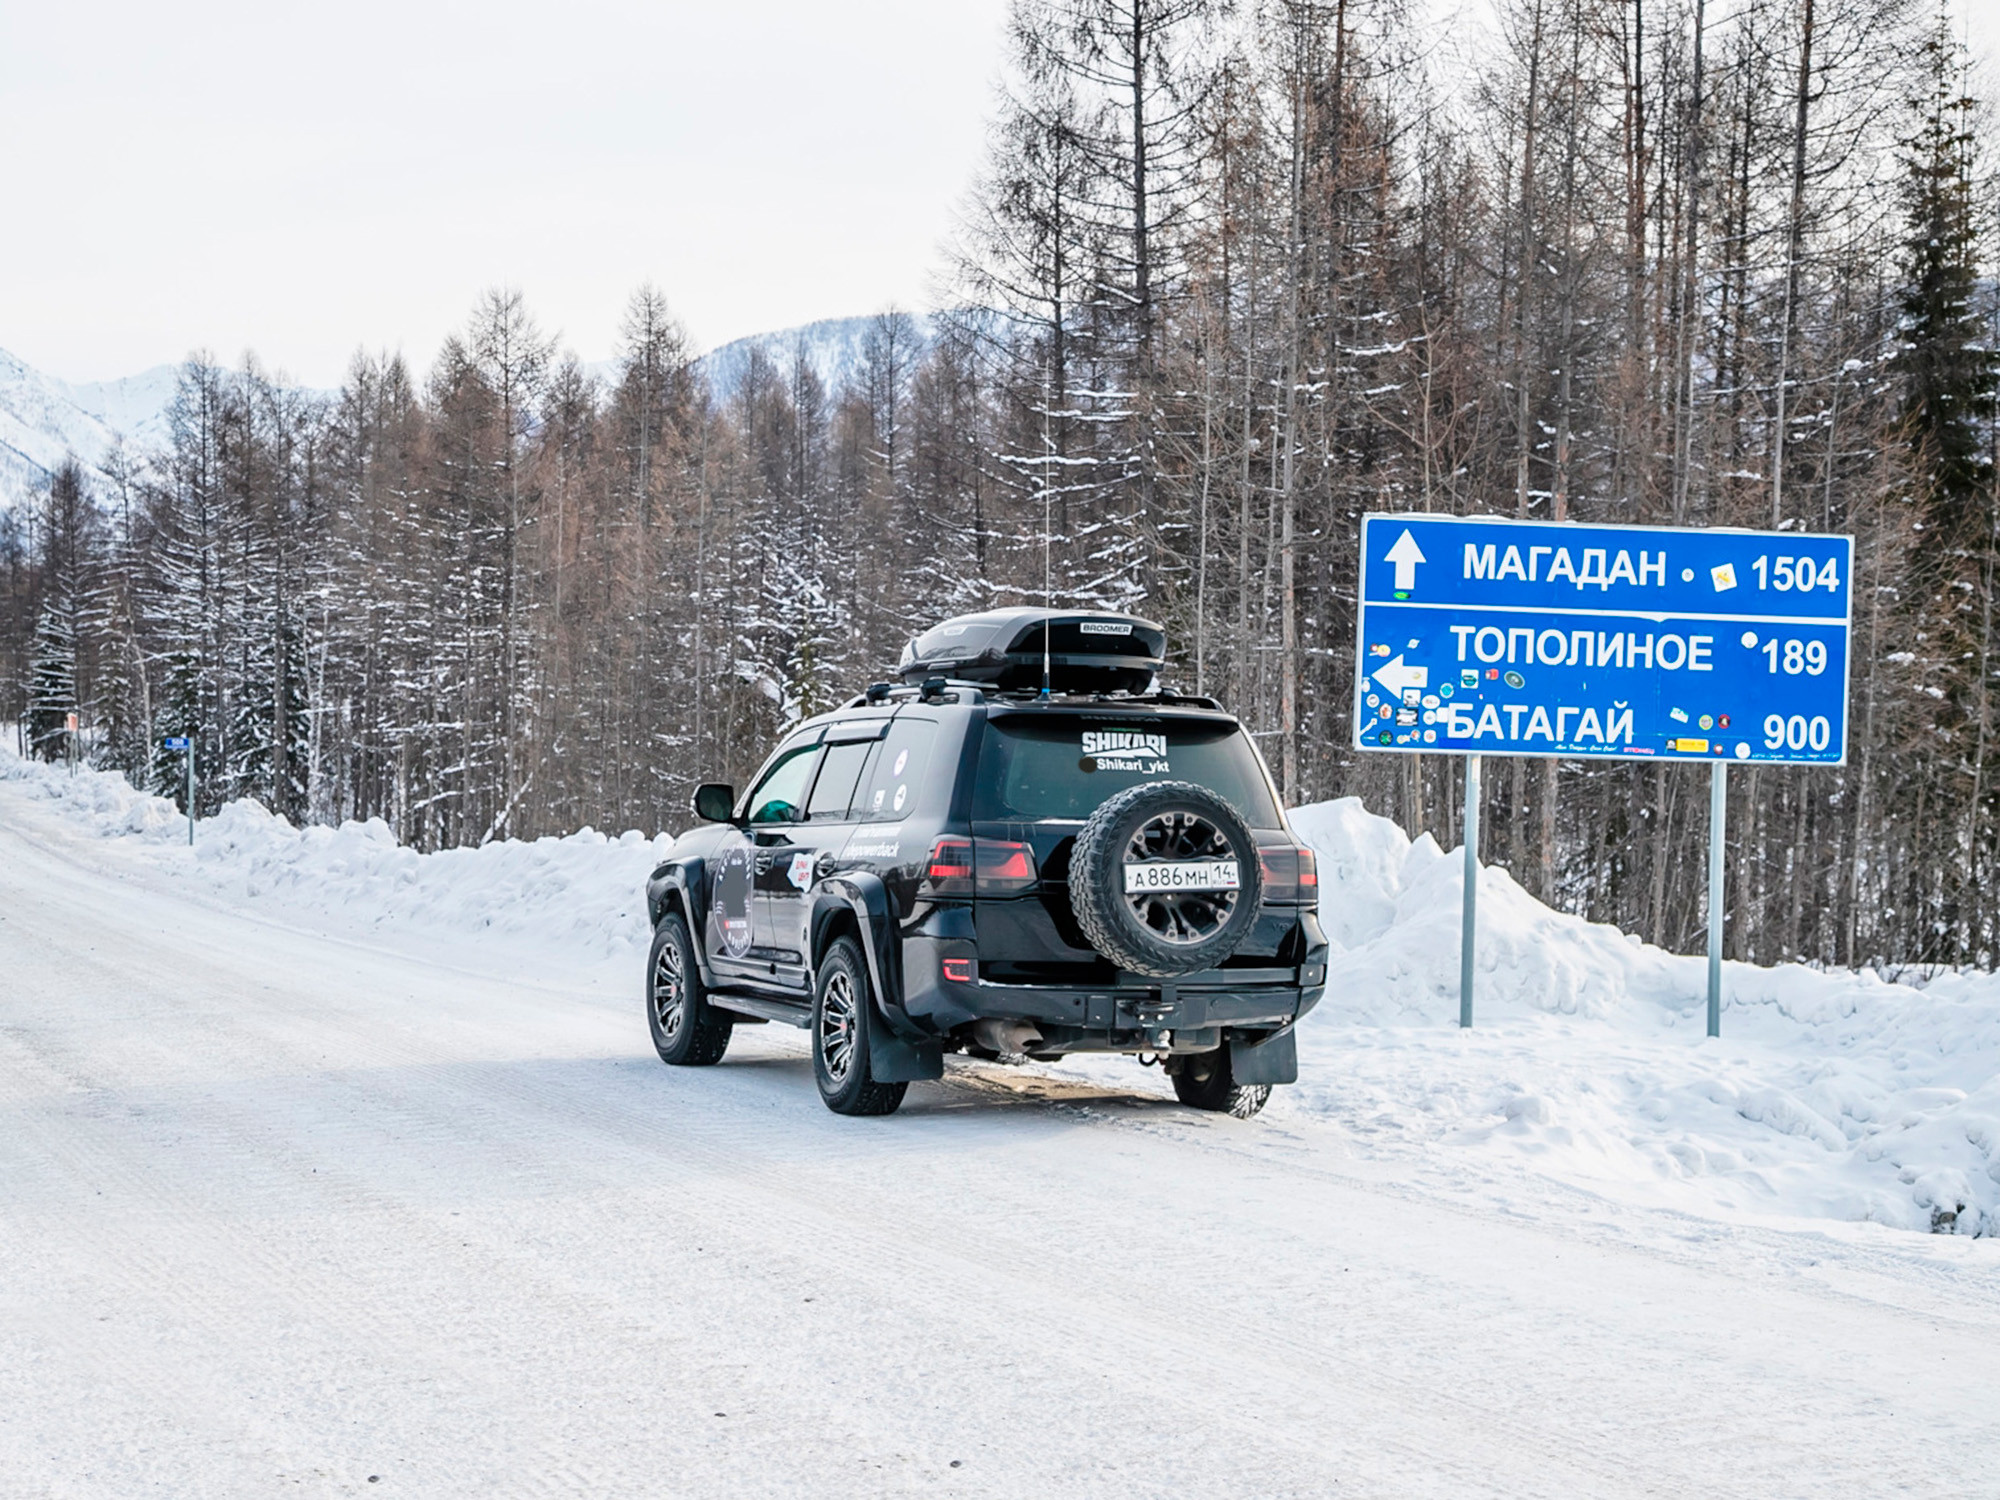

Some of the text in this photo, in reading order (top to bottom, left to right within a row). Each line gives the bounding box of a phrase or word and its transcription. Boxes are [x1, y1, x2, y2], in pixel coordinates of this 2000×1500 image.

[1463, 543, 1840, 593] МАГАДАН 1504
[1082, 623, 1130, 633] BROOMER
[1449, 625, 1828, 676] ТОПОЛИНОЕ 189
[1446, 700, 1831, 751] БАТАГАЙ 900
[1082, 731, 1167, 757] SHIKARI
[1096, 757, 1170, 775] Shikari_ykt
[1213, 865, 1232, 879] 14
